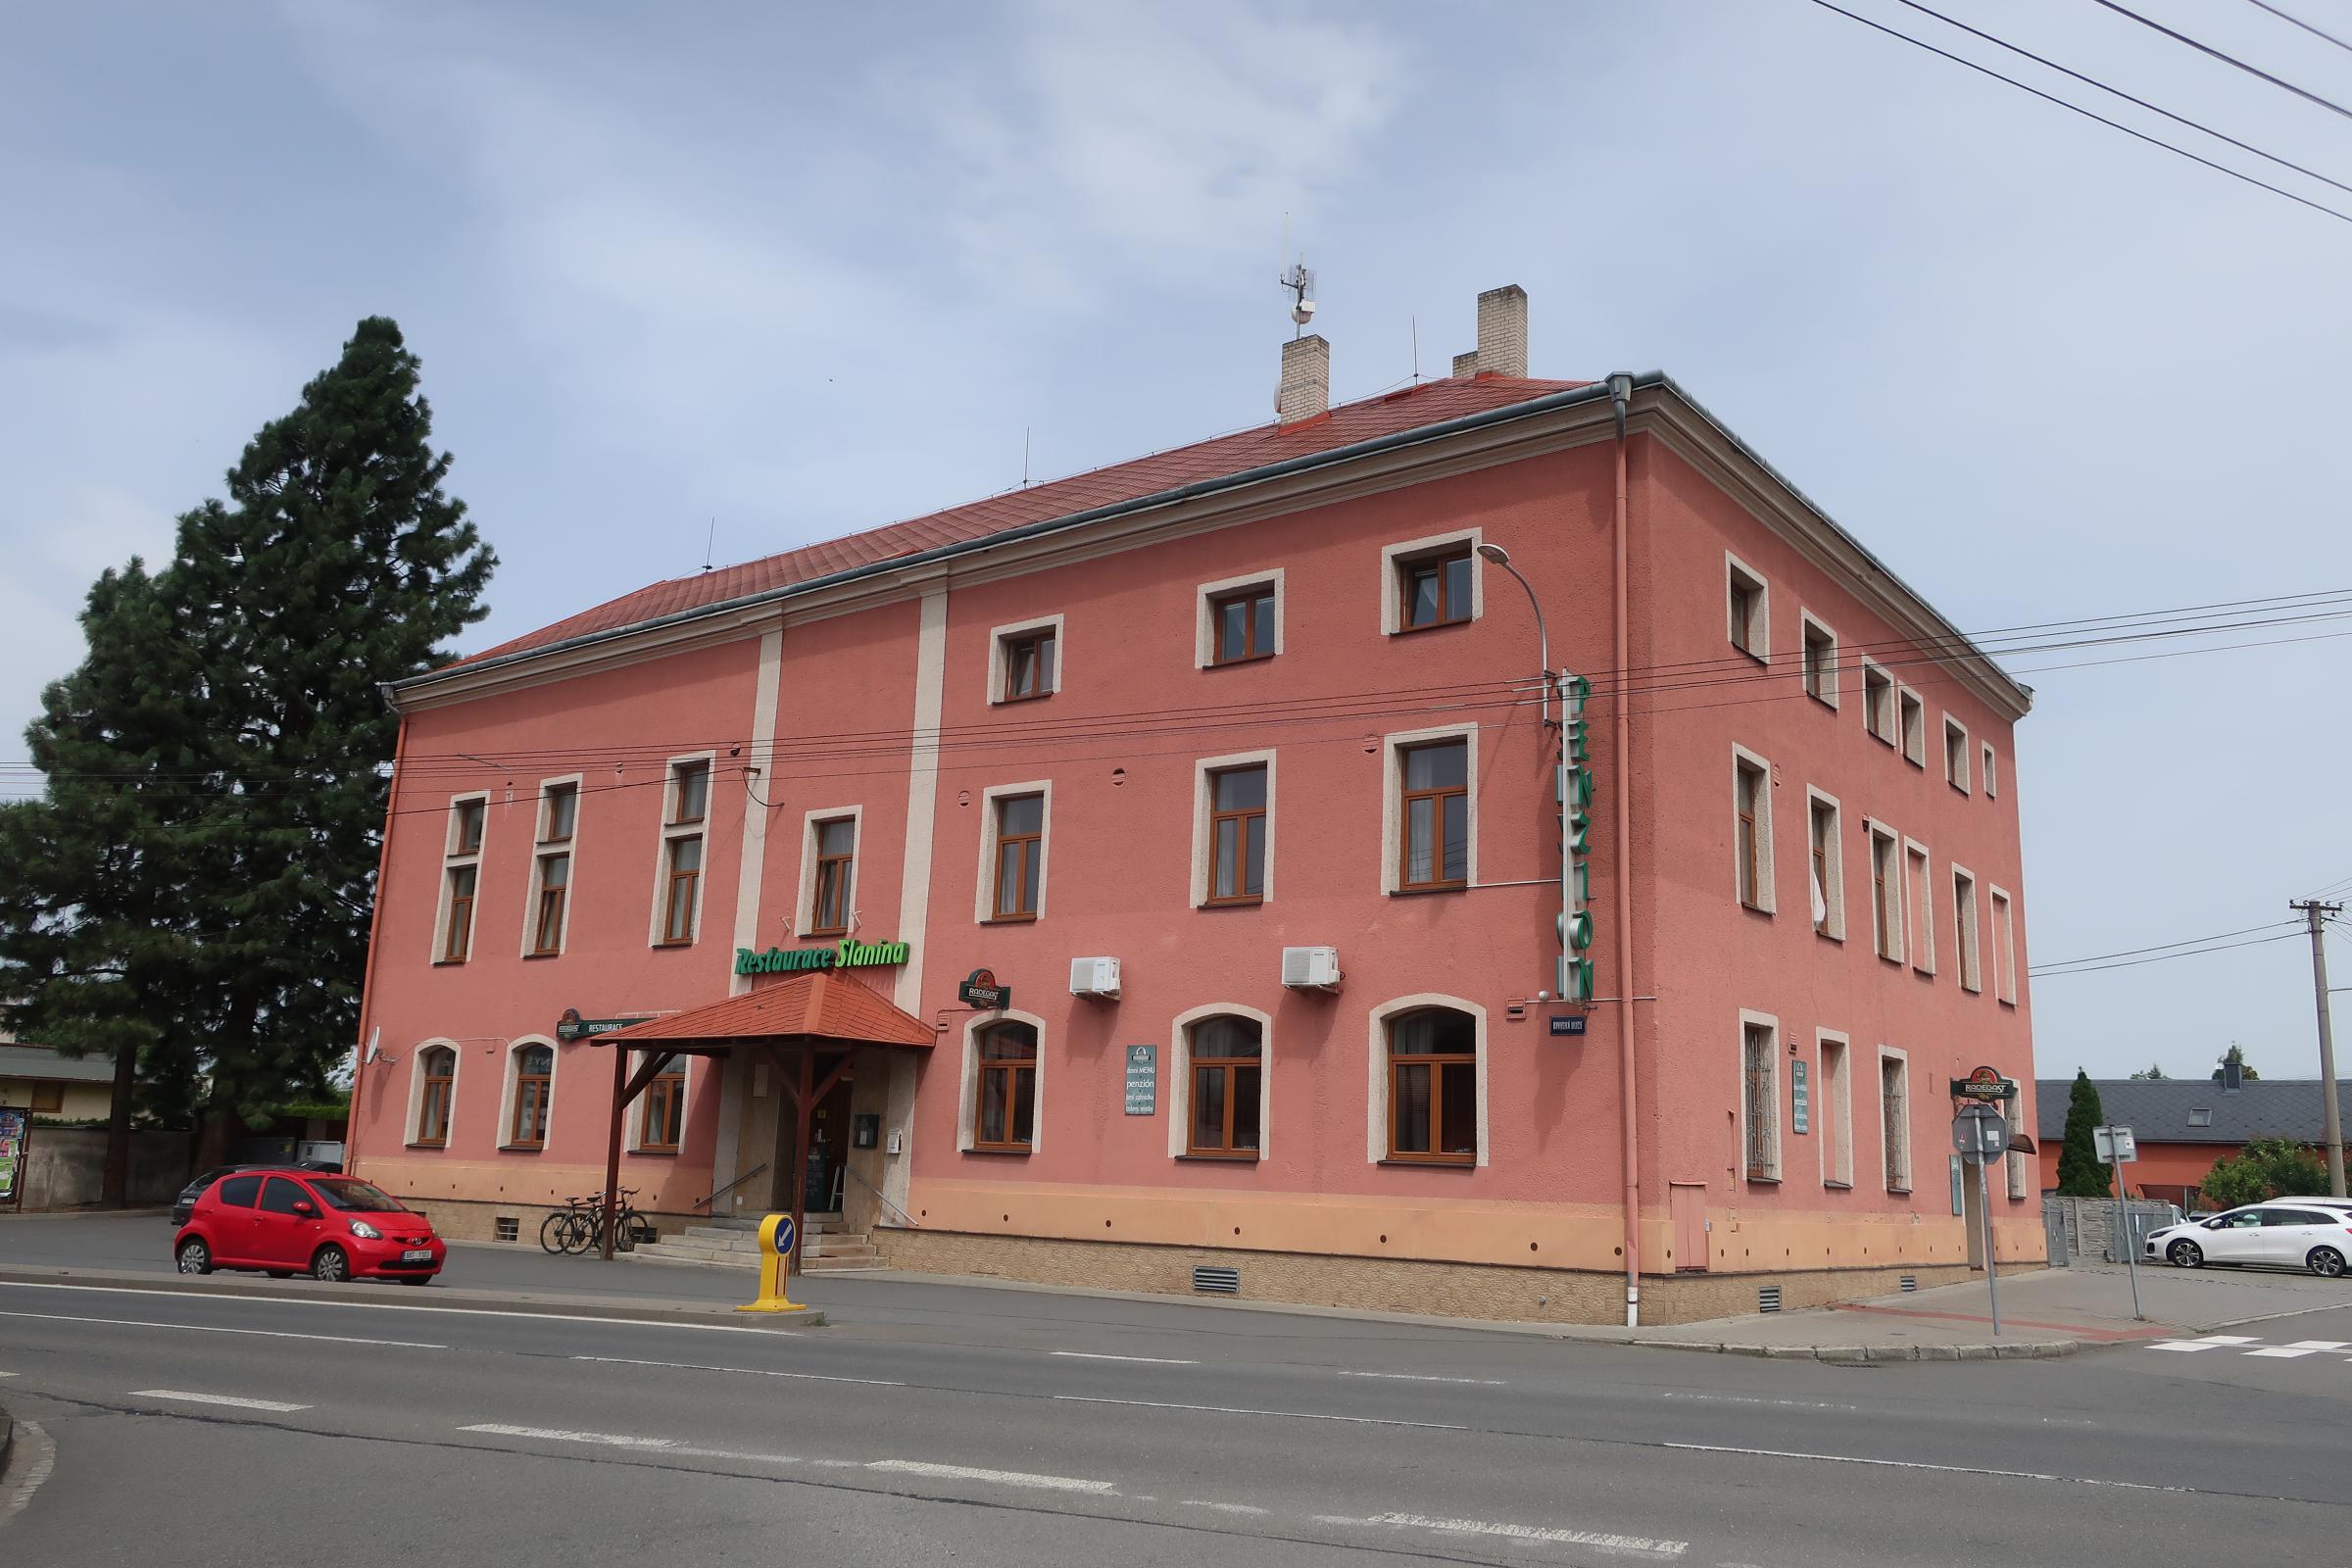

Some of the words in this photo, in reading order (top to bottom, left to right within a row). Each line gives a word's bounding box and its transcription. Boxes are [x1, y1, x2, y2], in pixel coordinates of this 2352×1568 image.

[1568, 675, 1594, 1002] PENZION
[735, 947, 837, 975] Restaurace
[835, 939, 909, 968] Slanina
[968, 987, 999, 1001] RADEGAST
[1965, 1084, 2007, 1094] RADEGAST
